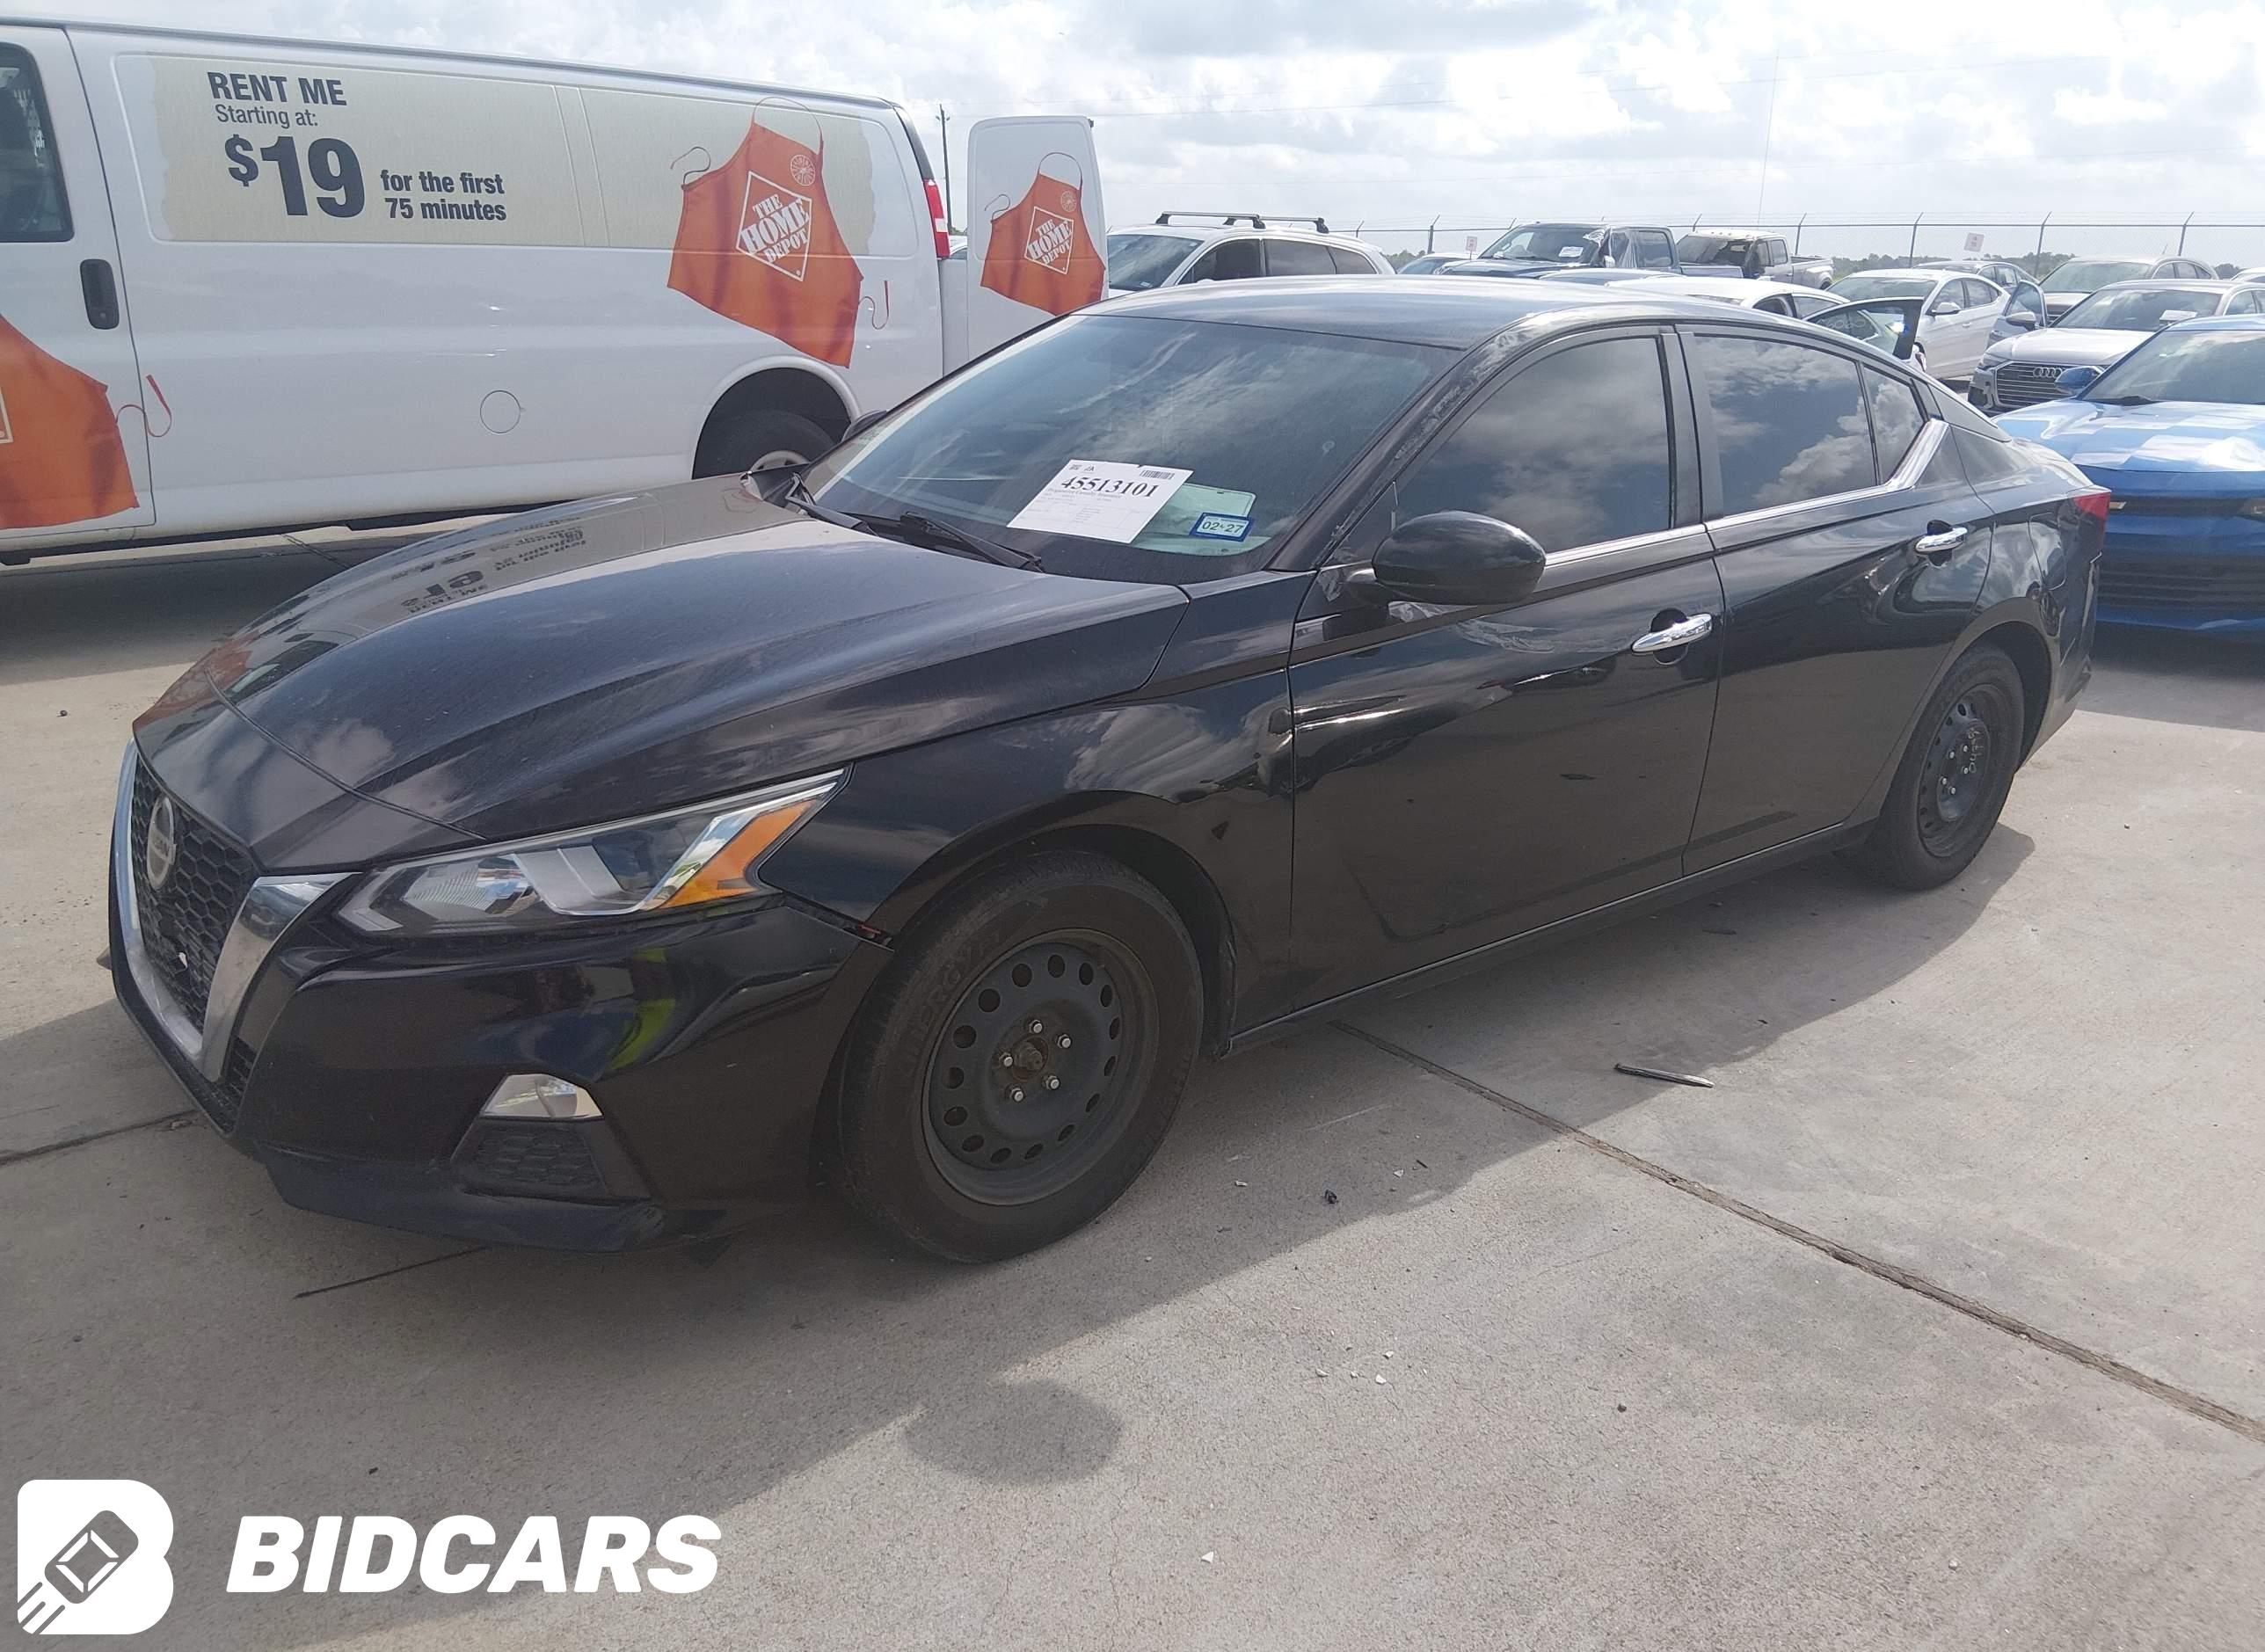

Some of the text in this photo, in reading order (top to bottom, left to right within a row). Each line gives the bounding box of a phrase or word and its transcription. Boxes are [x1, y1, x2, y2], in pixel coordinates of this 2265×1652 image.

[208, 72, 347, 106] RENT ME
[215, 104, 318, 129] Starting at:
[224, 134, 365, 218] $19
[380, 170, 505, 195] for the first
[384, 197, 507, 222] 75 minutes
[752, 193, 783, 220] THE
[740, 198, 810, 256] HOME
[1027, 220, 1072, 260] HOME
[1035, 219, 1055, 237] THE
[763, 228, 808, 264] DEPOT
[1041, 239, 1070, 265] DEPOT
[1061, 476, 1160, 497] 45513101
